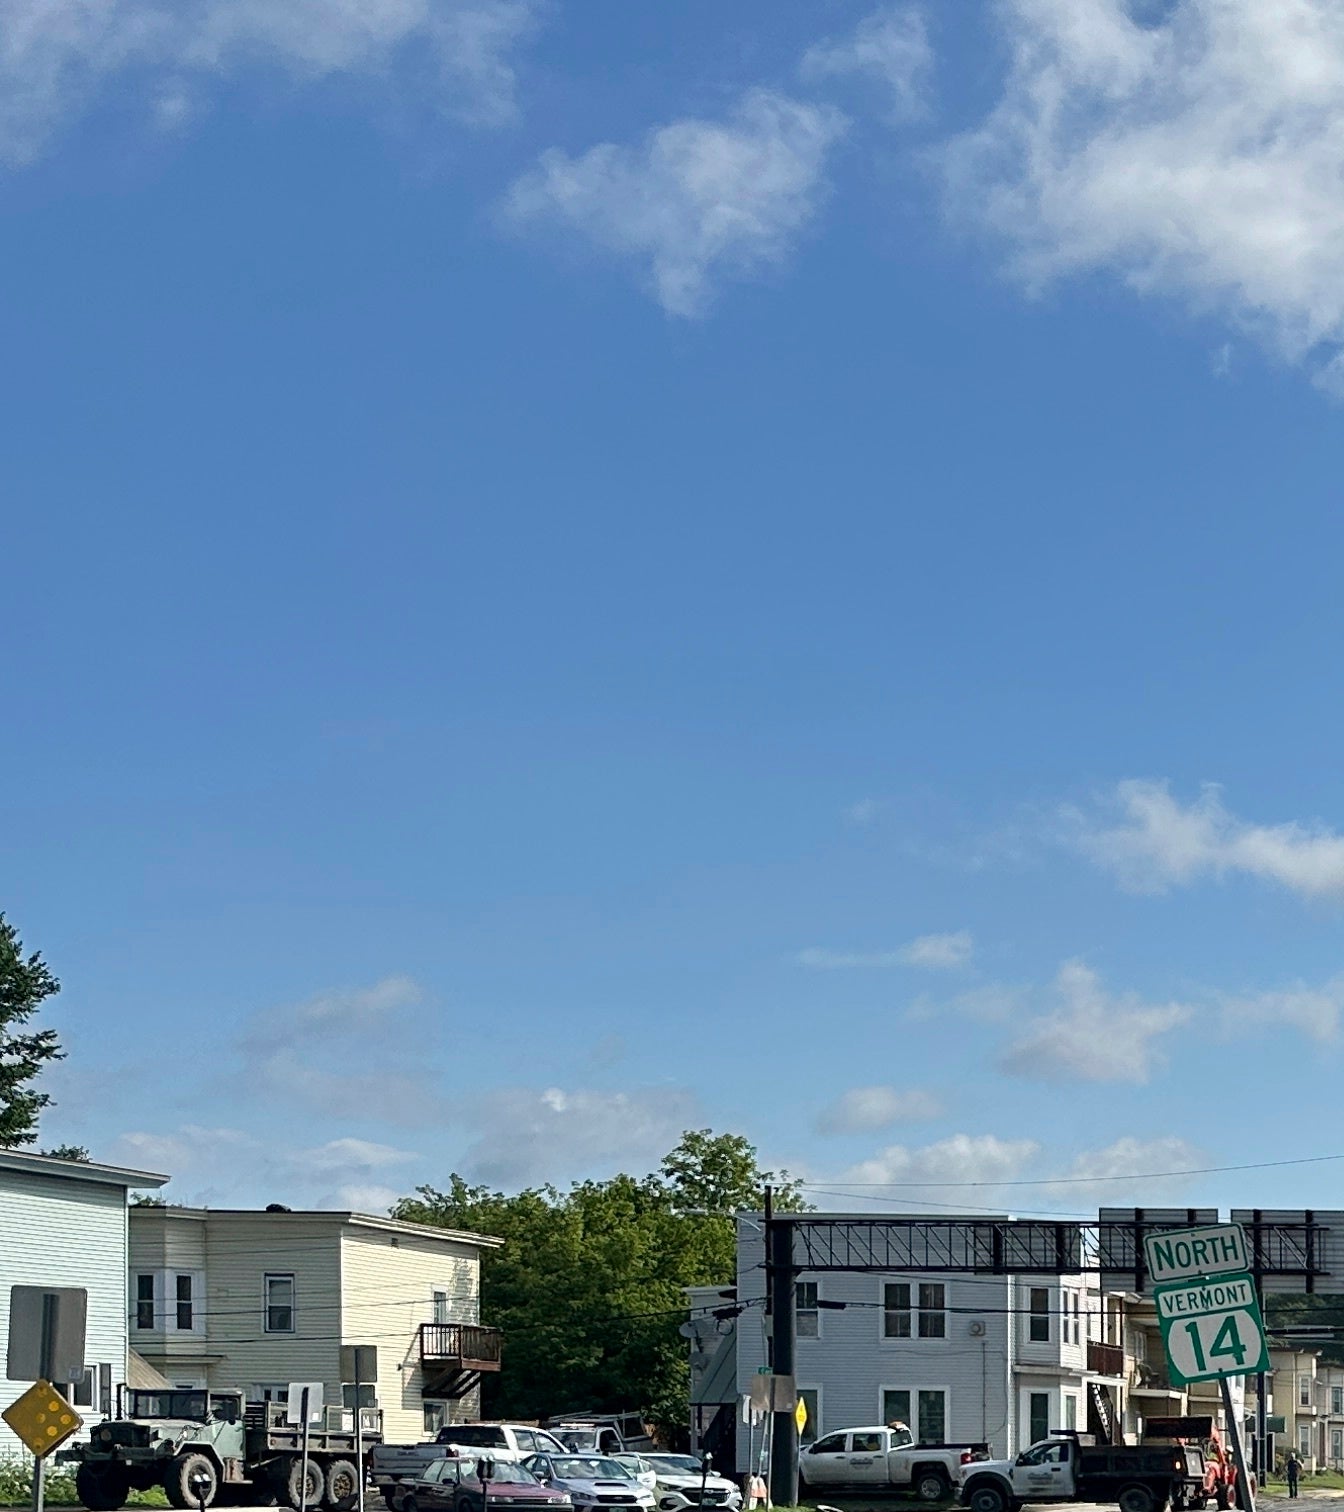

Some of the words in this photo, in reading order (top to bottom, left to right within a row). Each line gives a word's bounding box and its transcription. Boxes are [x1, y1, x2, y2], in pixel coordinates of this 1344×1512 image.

[1153, 1234, 1240, 1271] NORTH
[1162, 1283, 1247, 1314] VERMONT
[1185, 1315, 1247, 1372] 14
